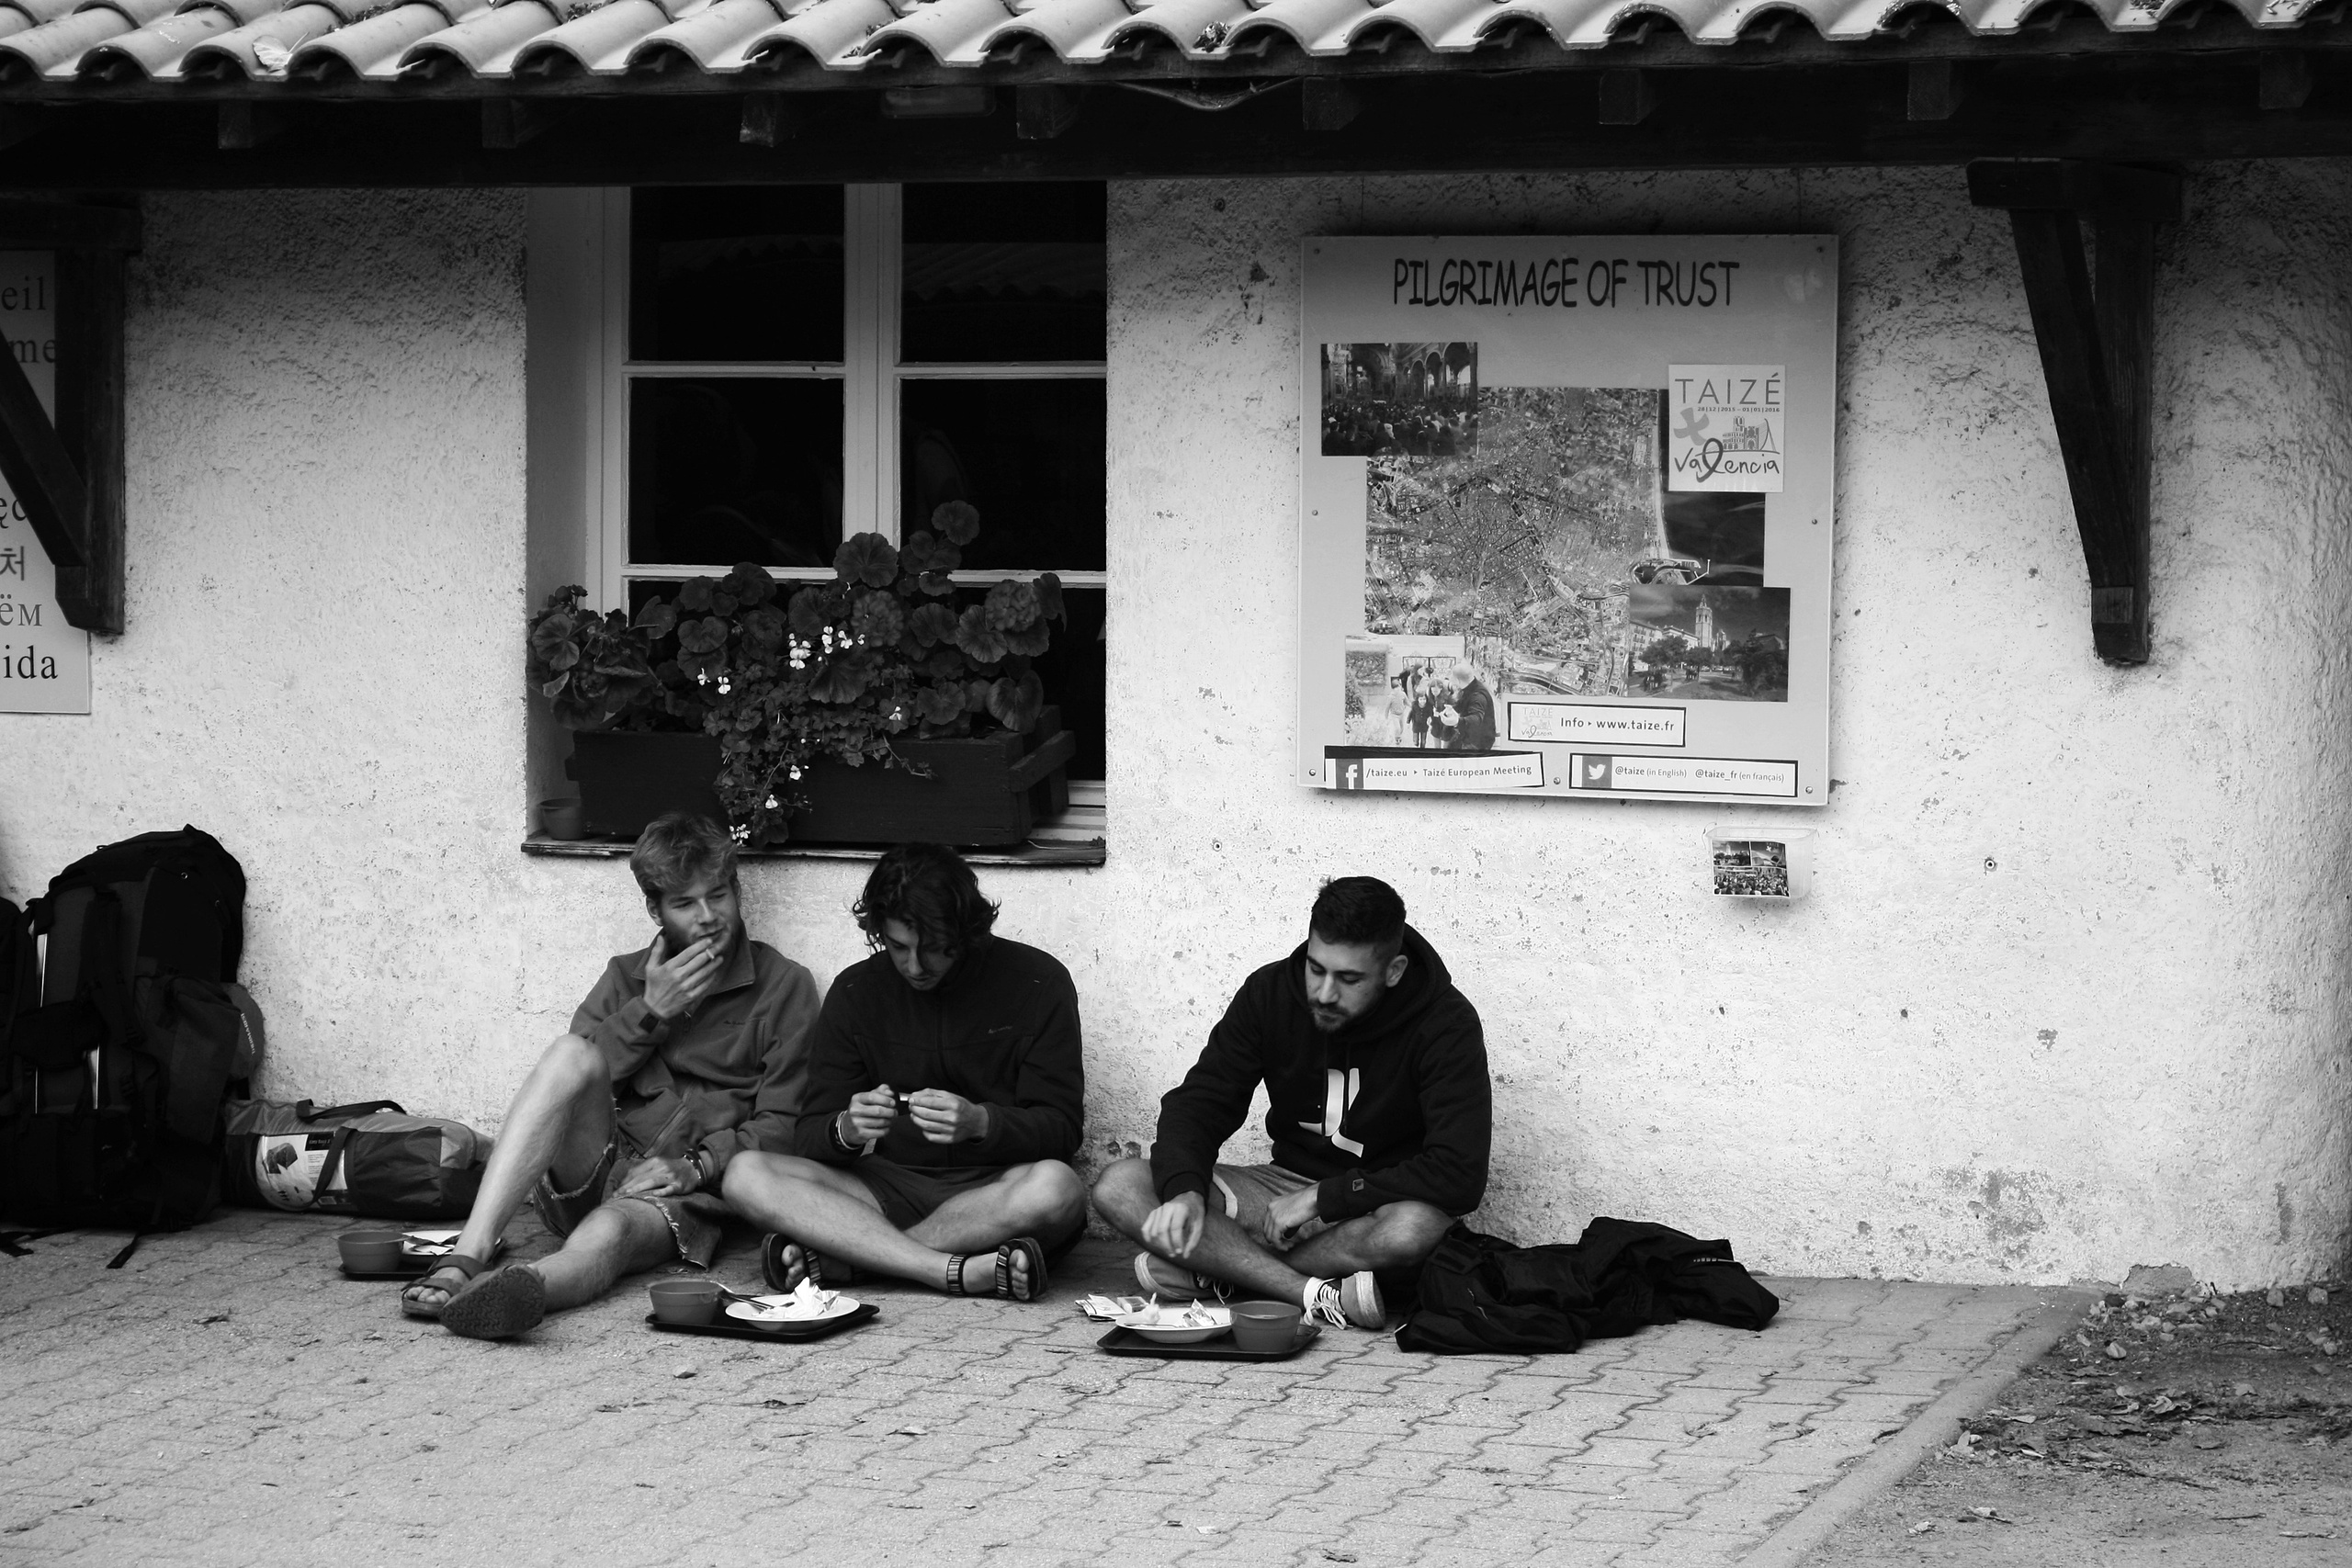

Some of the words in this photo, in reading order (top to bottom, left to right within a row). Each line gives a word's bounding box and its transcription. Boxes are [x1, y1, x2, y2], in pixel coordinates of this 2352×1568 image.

[1394, 258, 1579, 308] PILGRIMAGE
[1587, 258, 1629, 308] OF
[1636, 260, 1740, 307] TRUST
[1674, 372, 1781, 405] TAIZÉ
[1674, 437, 1780, 483] Valencia
[3, 645, 58, 680] ida
[1561, 717, 1585, 728] Info
[1596, 719, 1675, 731] www.taize.fr
[1365, 768, 1408, 778] /taize.eu
[1423, 768, 1446, 777] Taizé
[1448, 768, 1490, 779] European
[1493, 765, 1532, 776] Meeting
[1614, 765, 1645, 776] @taize
[1646, 768, 1657, 778] (in
[1657, 769, 1688, 779] English)
[1695, 769, 1738, 781] @taize_fr
[1738, 771, 1751, 781] (en
